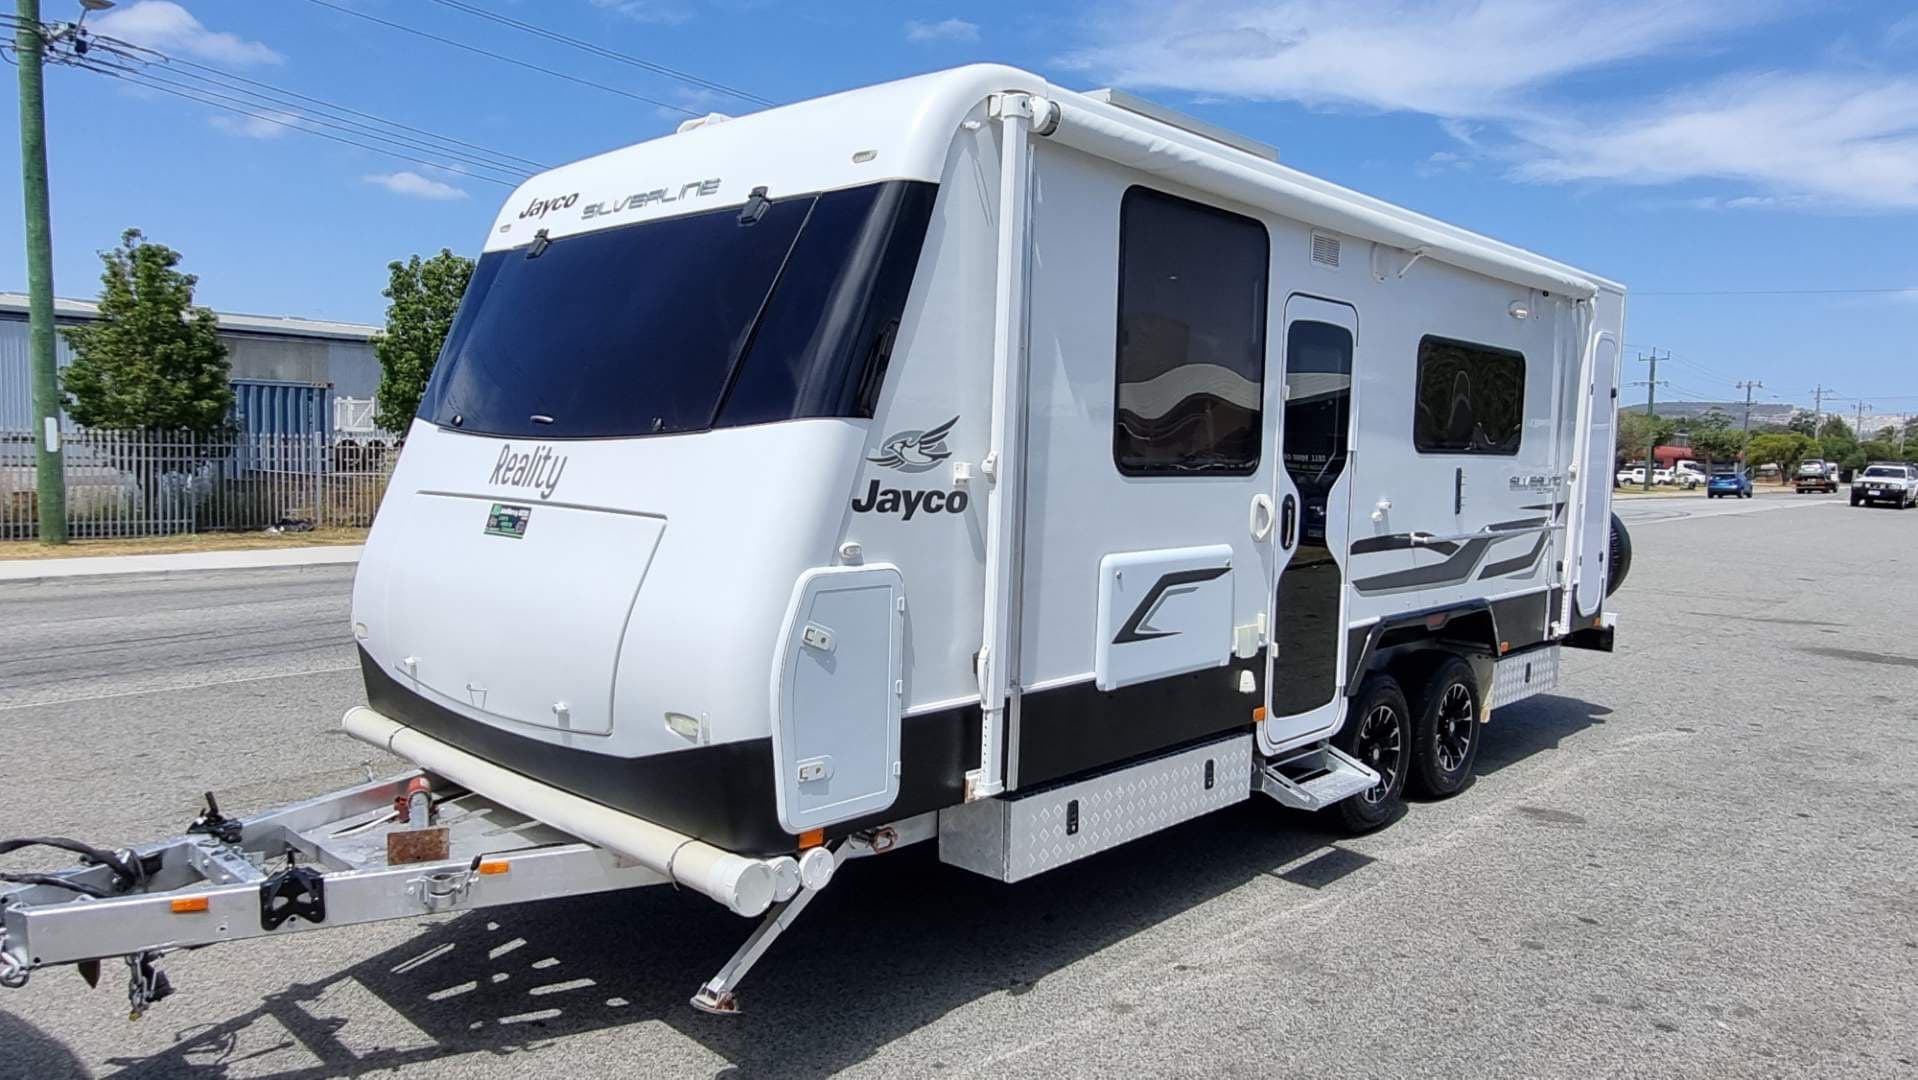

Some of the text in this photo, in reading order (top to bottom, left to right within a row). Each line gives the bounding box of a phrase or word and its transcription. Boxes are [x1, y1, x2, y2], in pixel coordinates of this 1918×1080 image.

[518, 178, 721, 221] Jayco SILVERLINE
[488, 443, 568, 500] Reality
[851, 479, 969, 521] Jayco
